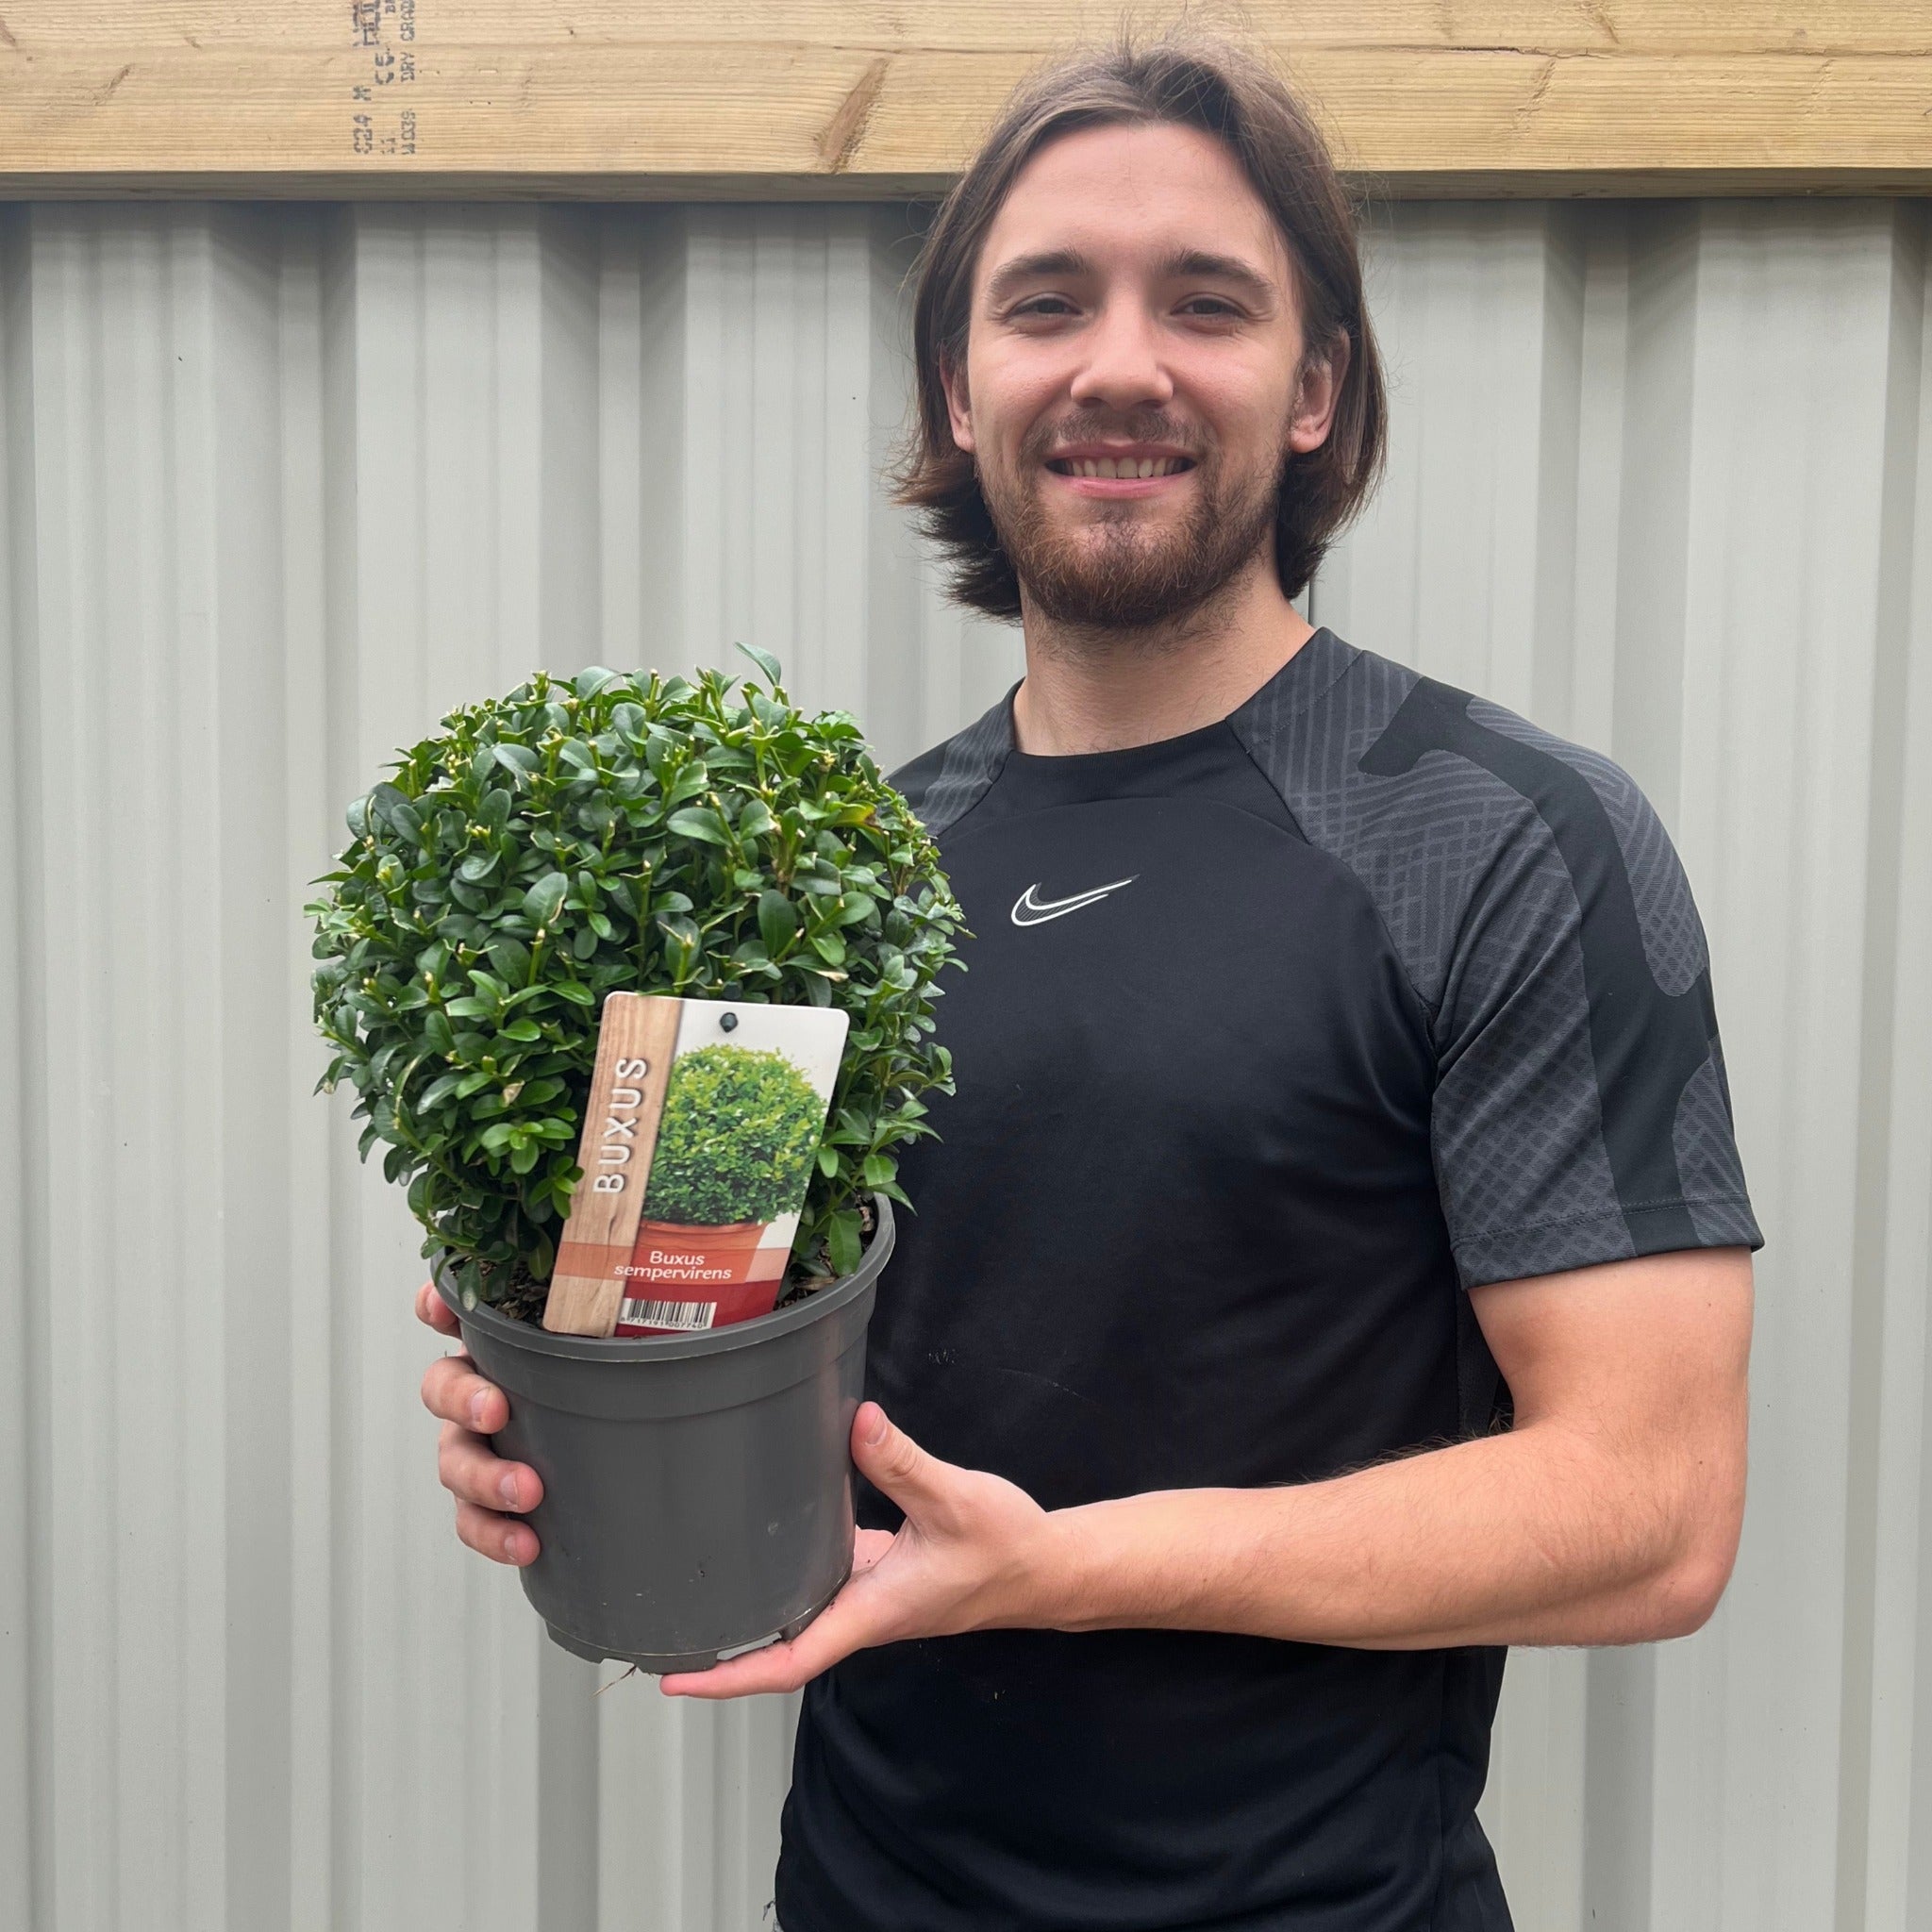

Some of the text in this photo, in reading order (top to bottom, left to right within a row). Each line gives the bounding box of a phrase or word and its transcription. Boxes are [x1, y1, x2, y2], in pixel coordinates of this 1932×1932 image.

[401, 52, 415, 82] DRY
[592, 1058, 648, 1194] BUXUS
[649, 1251, 705, 1266] Buxus
[613, 1265, 732, 1281] sempervirens
